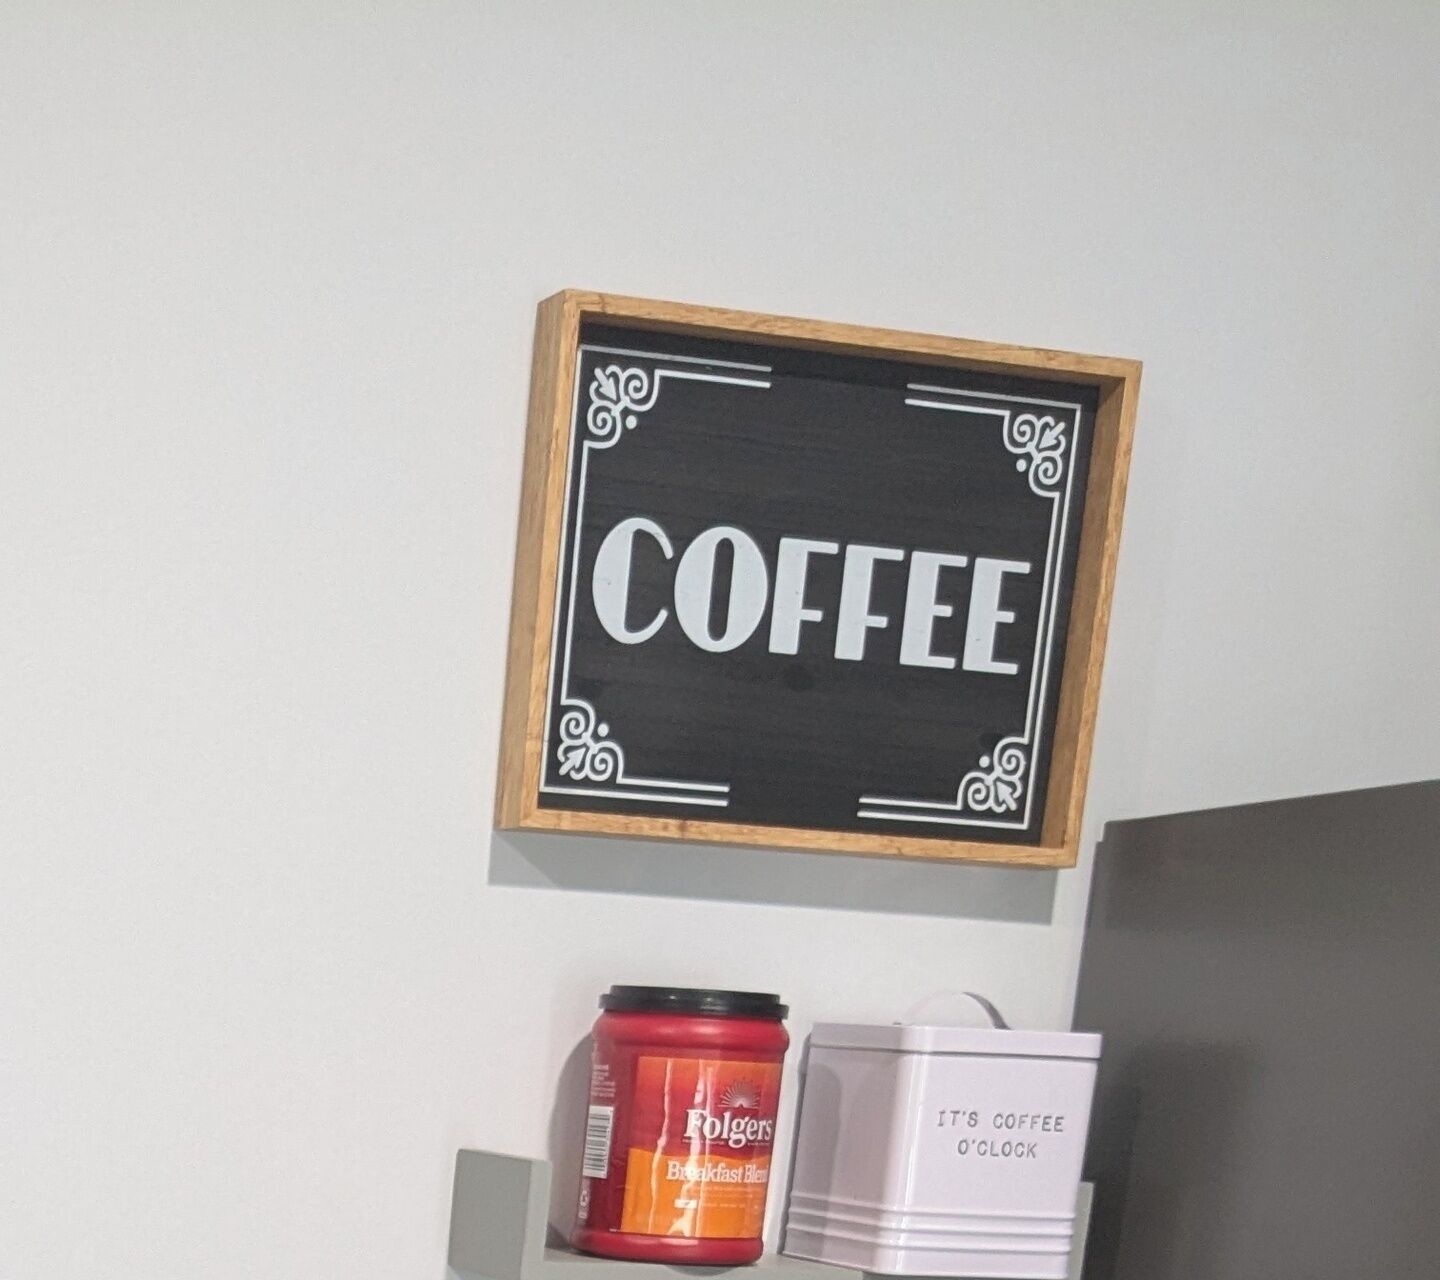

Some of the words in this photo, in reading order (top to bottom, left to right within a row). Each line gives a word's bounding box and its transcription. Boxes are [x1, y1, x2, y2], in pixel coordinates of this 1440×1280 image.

[591, 516, 1032, 676] COFFEE
[683, 1108, 774, 1149] Folgers
[937, 1110, 979, 1128] IT'S
[992, 1113, 1065, 1133] COFFEE
[957, 1139, 1038, 1159] O'CLOCK
[666, 1160, 744, 1184] Breakfast
